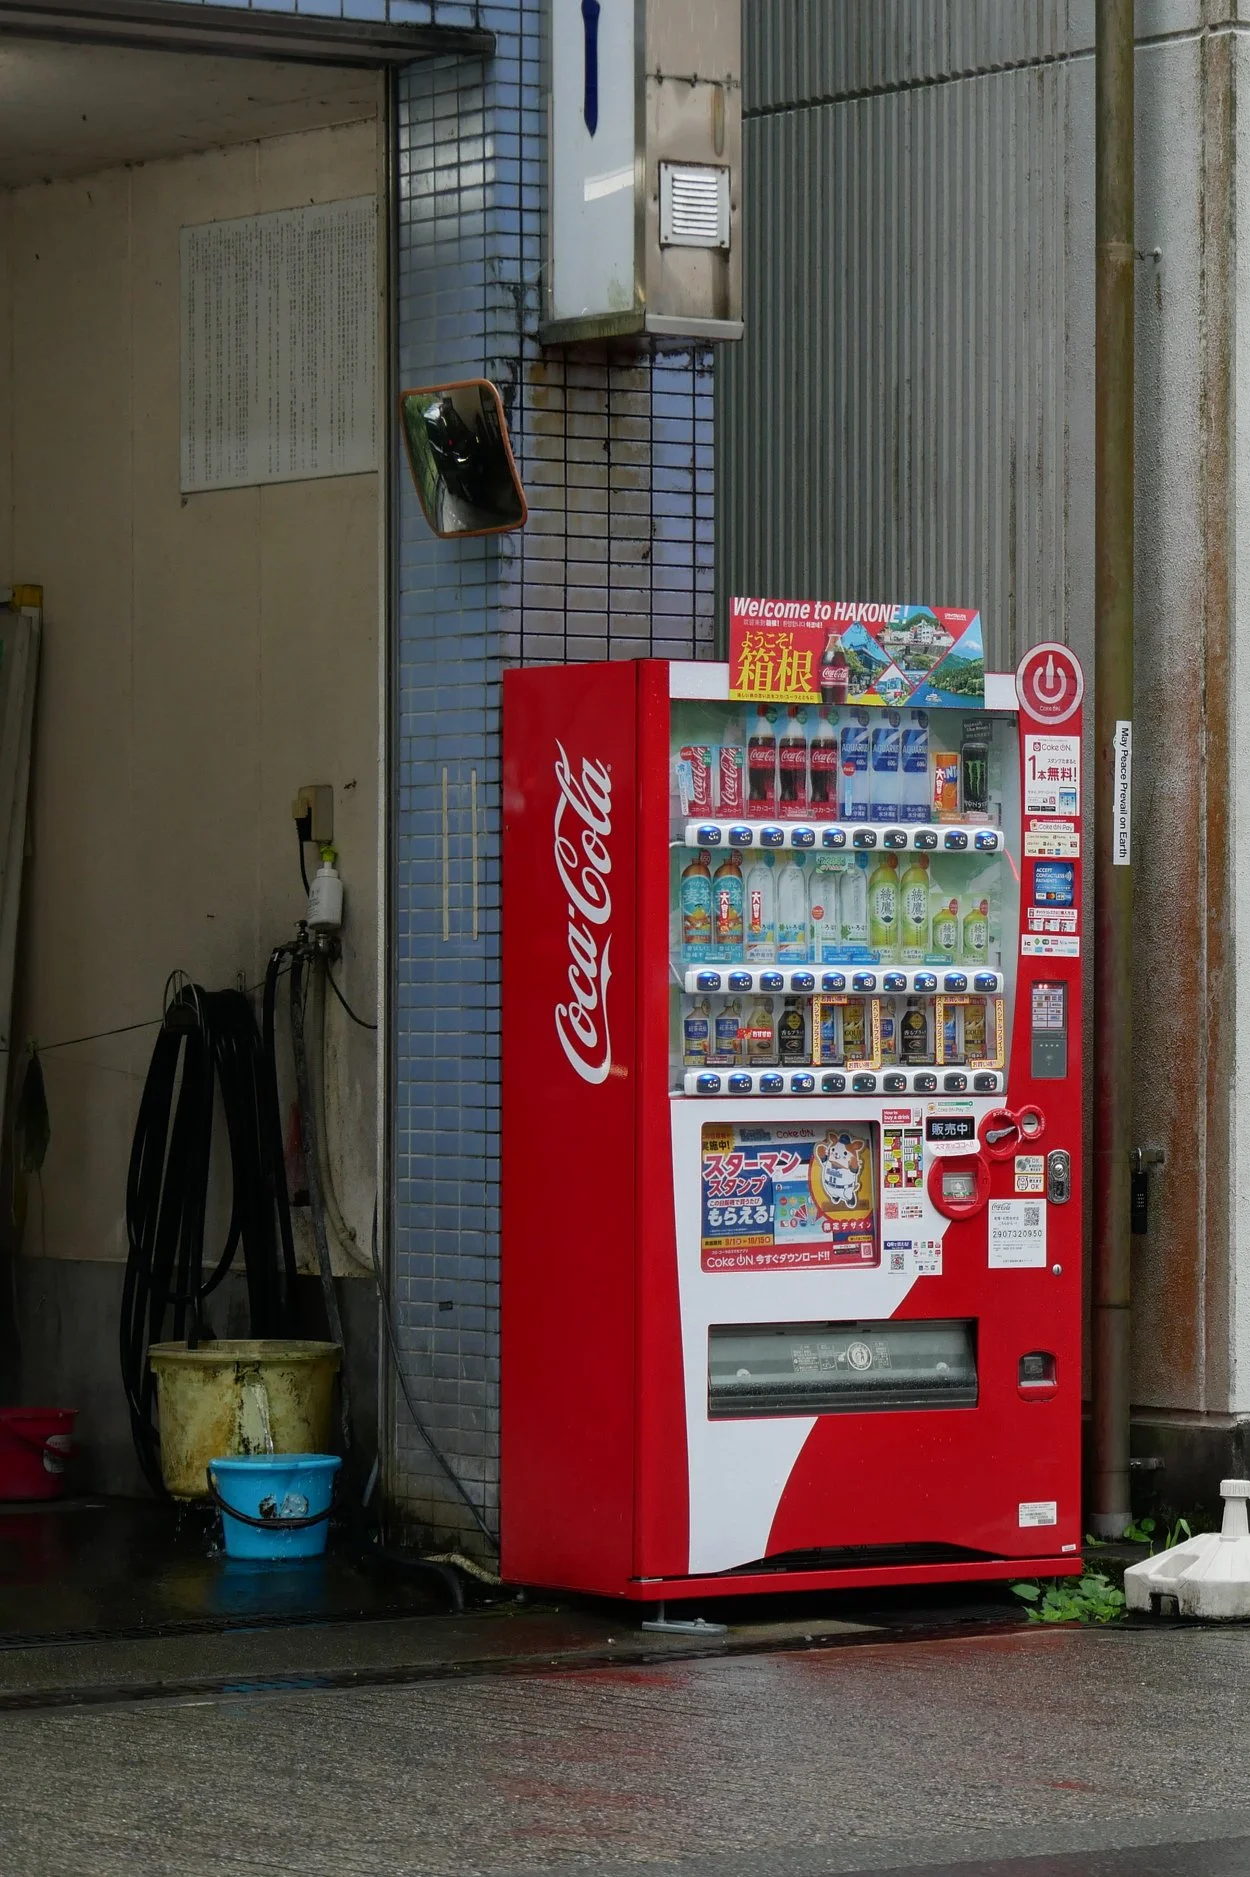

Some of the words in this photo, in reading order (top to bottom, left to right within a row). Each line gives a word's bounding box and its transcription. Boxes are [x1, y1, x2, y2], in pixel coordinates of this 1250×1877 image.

[734, 597, 810, 619] Welcome
[814, 601, 831, 620] to
[834, 602, 909, 624] HAKONE!
[741, 631, 794, 649] ようこそ!
[736, 647, 813, 692] 箱根
[1041, 743, 1059, 751] Coke
[1120, 727, 1129, 748] May
[1119, 749, 1129, 780] Peace
[1119, 782, 1128, 815] Prevail
[1119, 817, 1127, 829] on
[1119, 832, 1128, 858] Earth
[554, 737, 613, 1085] Coca-Cola
[776, 1129, 799, 1138] Coke
[931, 1123, 968, 1135] 販売中
[703, 1151, 801, 1180] スターマン
[707, 1175, 766, 1197] スタンプ
[708, 1205, 775, 1226] もらえる!
[824, 1221, 872, 1231] 限定デザイン
[706, 1256, 735, 1267] Coke
